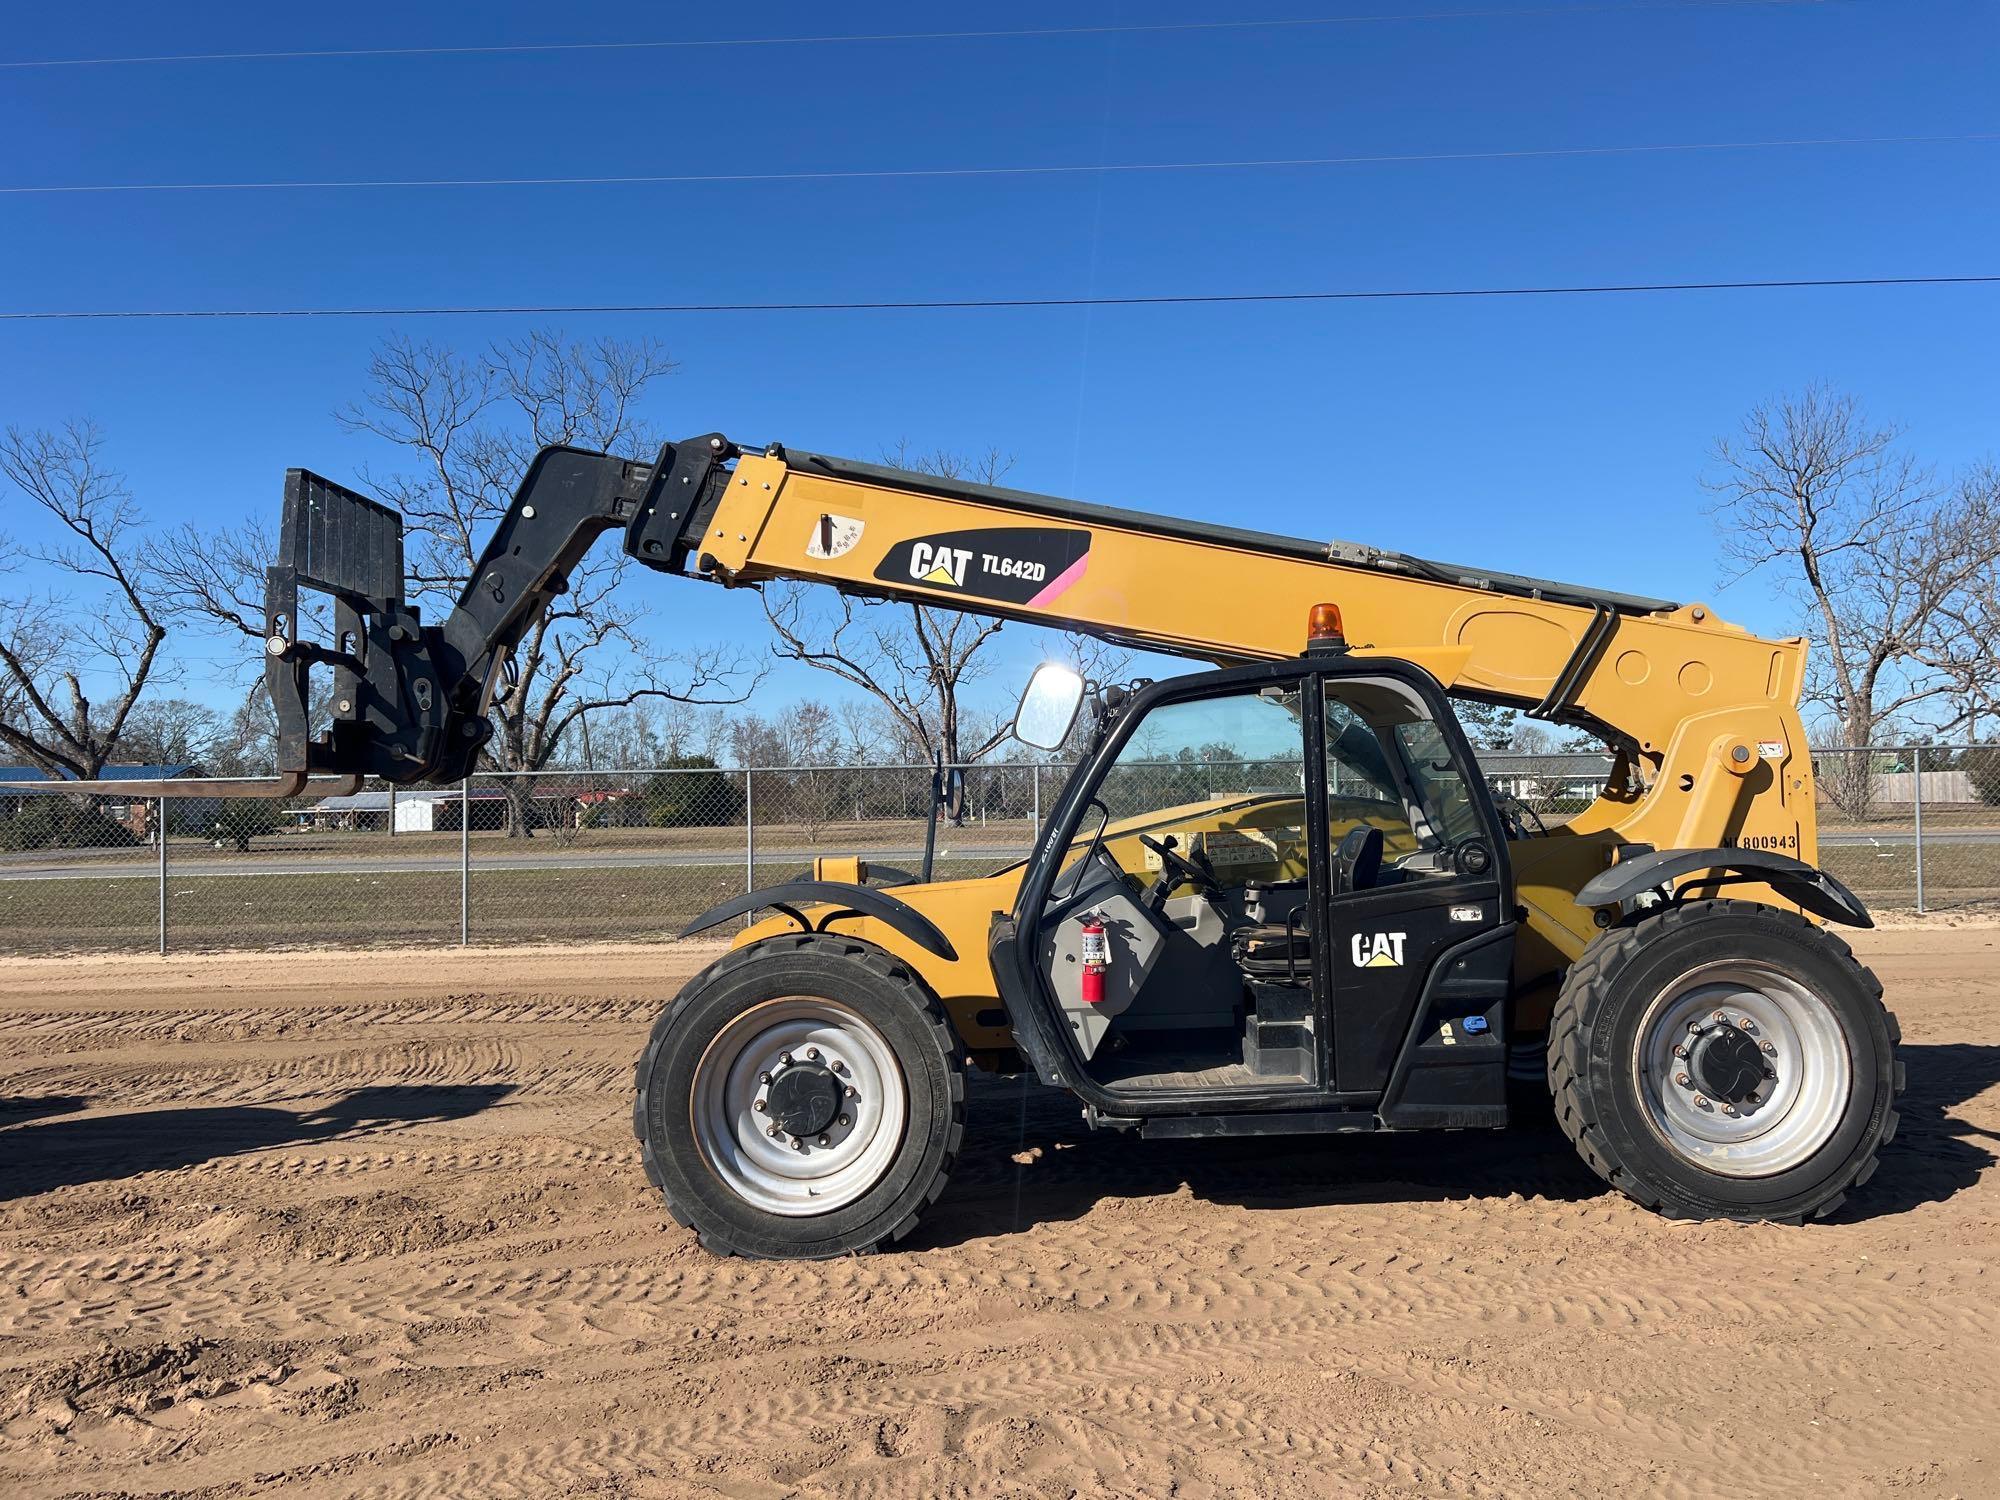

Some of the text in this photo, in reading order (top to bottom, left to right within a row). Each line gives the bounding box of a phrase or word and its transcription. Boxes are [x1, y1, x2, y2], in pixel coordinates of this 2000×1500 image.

[909, 542, 1046, 587] CAT TL642D
[1351, 932, 1407, 968] CAT
